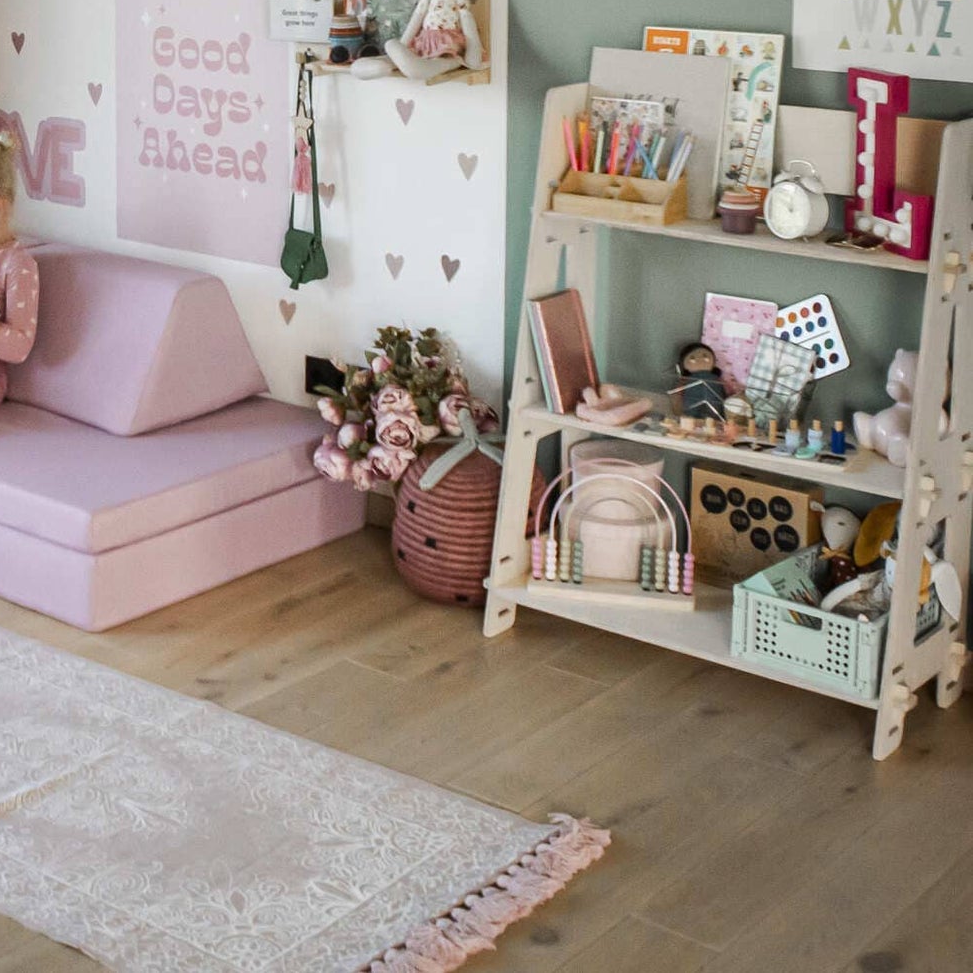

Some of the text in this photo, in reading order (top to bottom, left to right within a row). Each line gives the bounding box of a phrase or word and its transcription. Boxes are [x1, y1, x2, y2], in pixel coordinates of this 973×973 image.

[153, 26, 251, 75] Good
[153, 73, 251, 136] Days
[138, 127, 268, 184] Ahead
[844, 67, 933, 261] L
